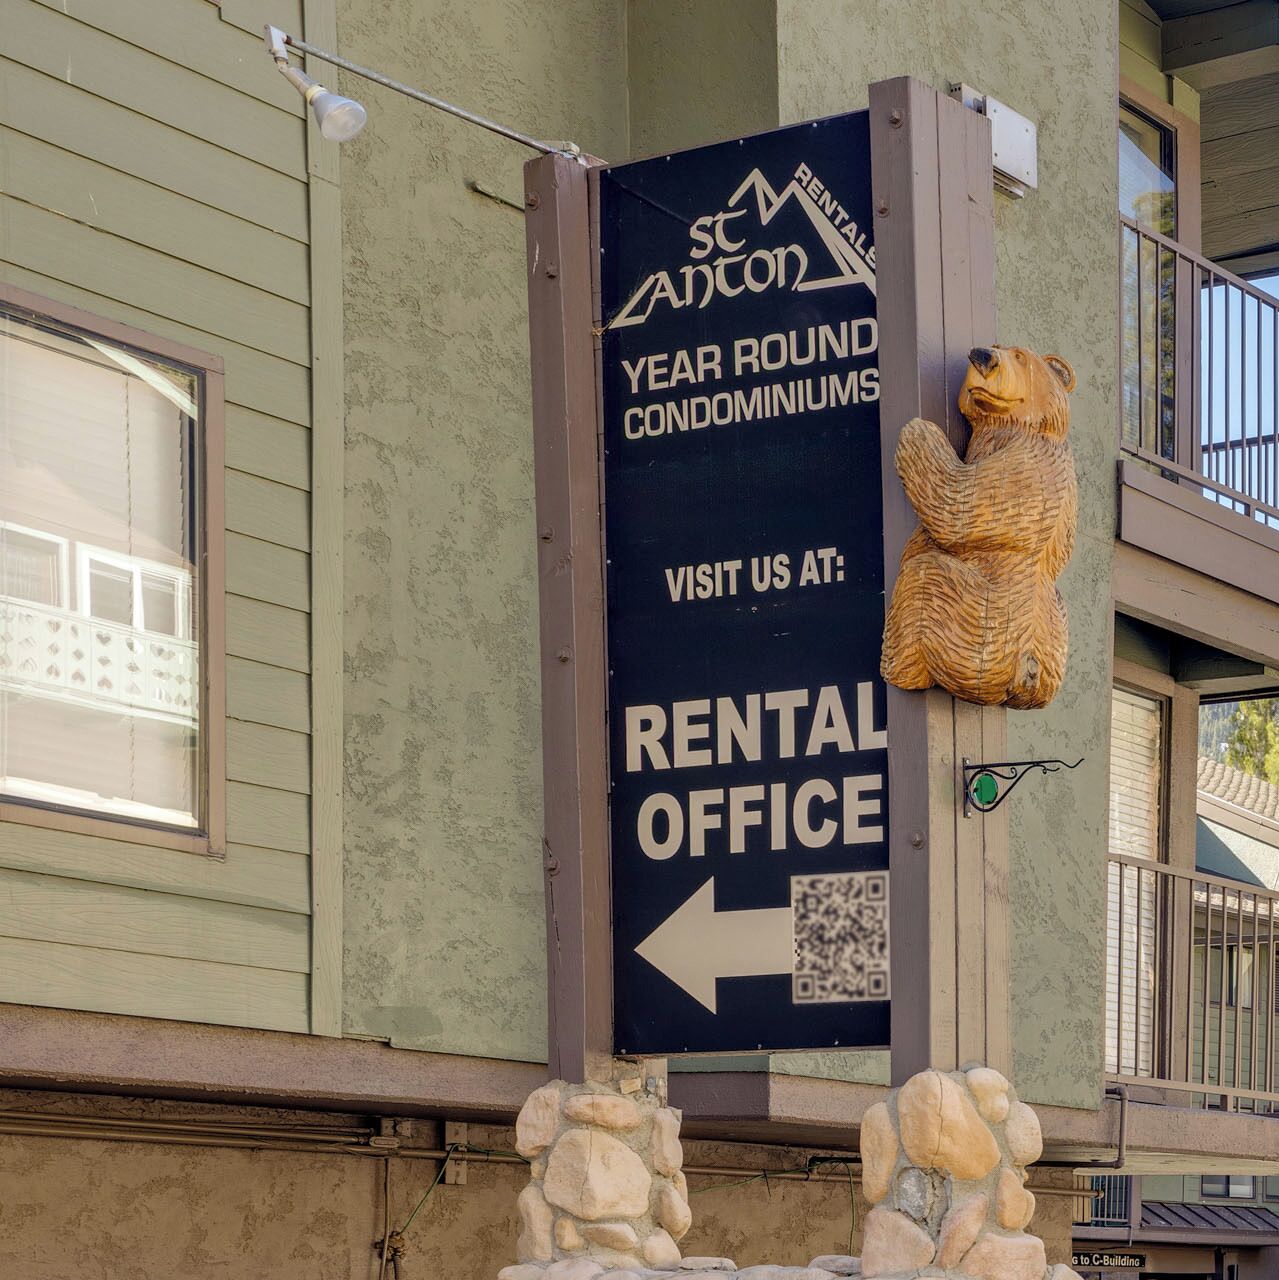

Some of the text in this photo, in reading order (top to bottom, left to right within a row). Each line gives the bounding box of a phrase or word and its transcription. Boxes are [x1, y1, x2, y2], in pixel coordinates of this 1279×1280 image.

[793, 162, 876, 272] RENTALS
[640, 244, 809, 312] Anton
[622, 317, 879, 393] YEAR ROUND
[623, 367, 880, 440] CONDOMINIUMS
[665, 547, 844, 603] VISIT US AT:
[625, 681, 888, 773] RENTAL
[637, 774, 884, 861] OFFICE
[1080, 1254, 1090, 1265] to
[1092, 1254, 1140, 1267] C-Building
